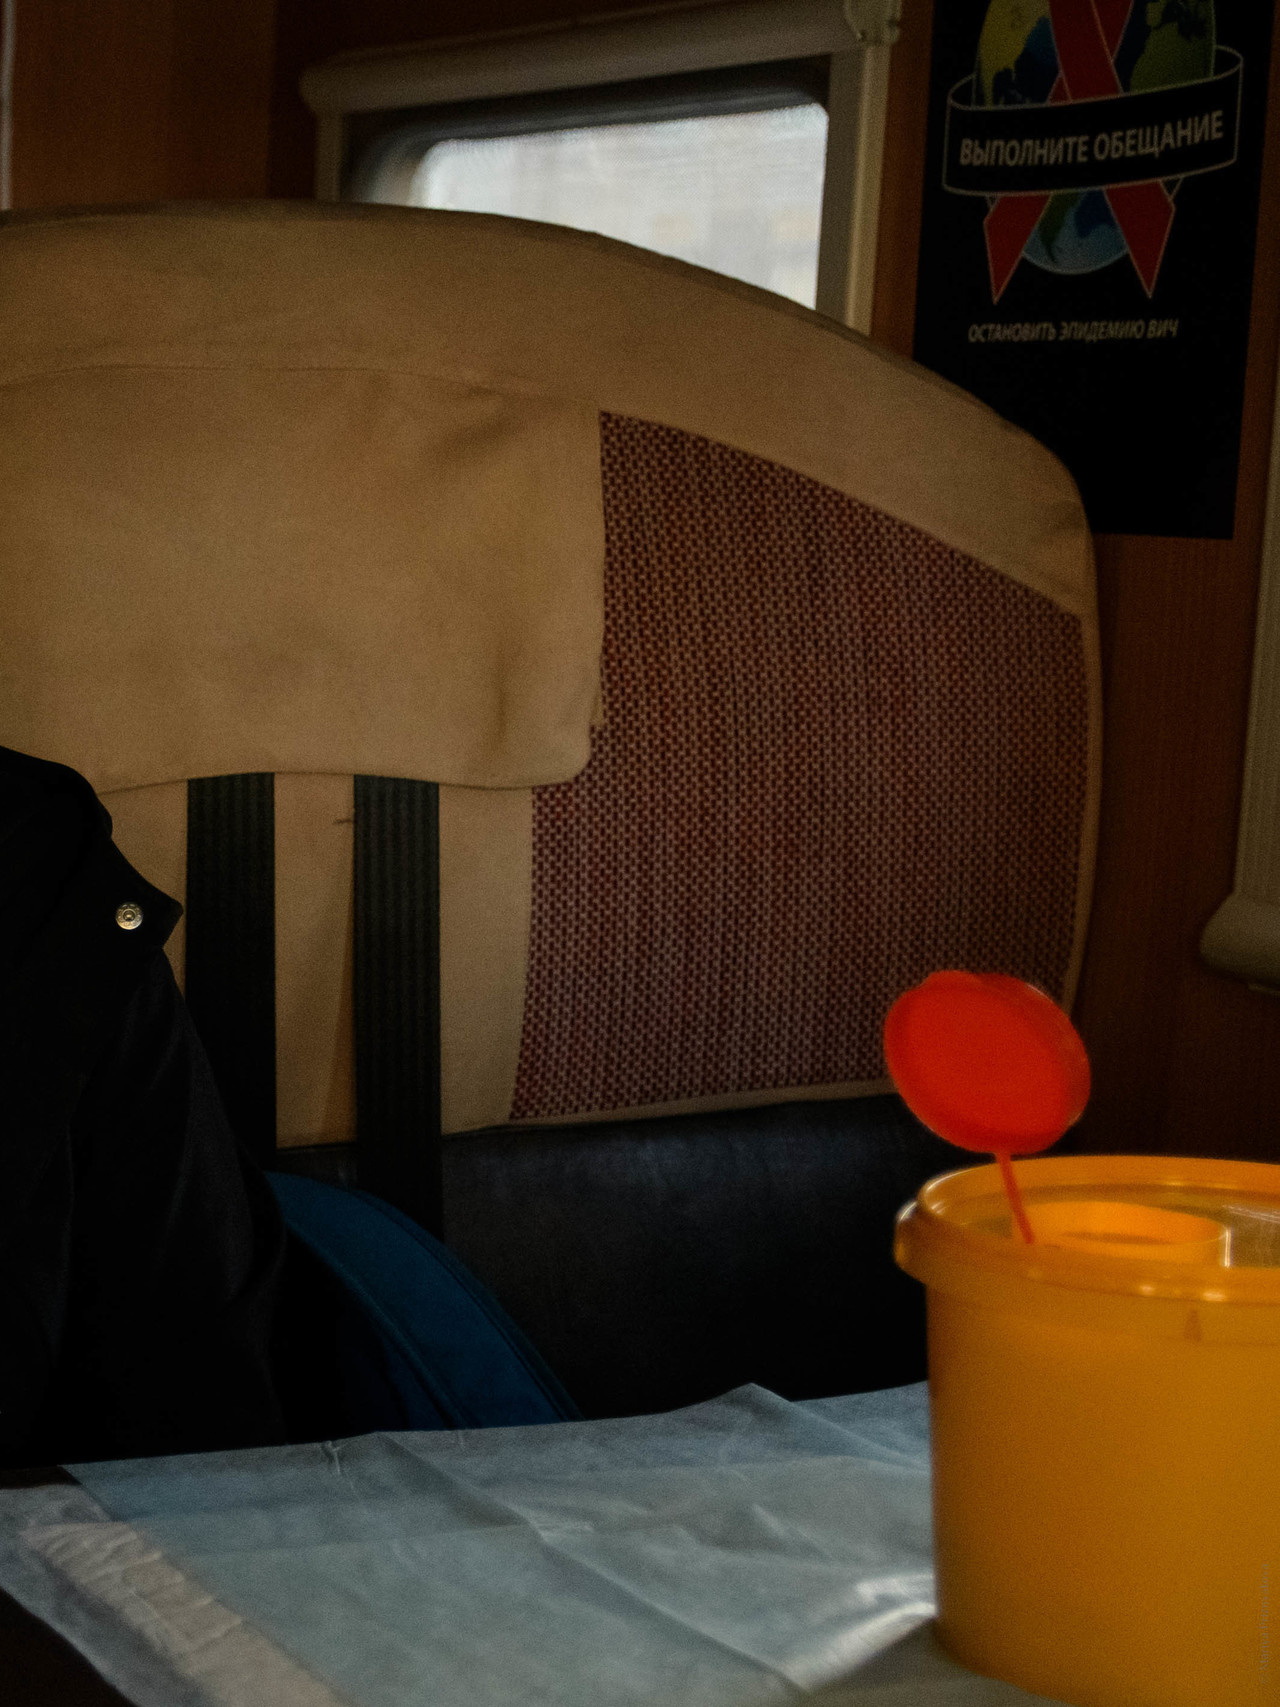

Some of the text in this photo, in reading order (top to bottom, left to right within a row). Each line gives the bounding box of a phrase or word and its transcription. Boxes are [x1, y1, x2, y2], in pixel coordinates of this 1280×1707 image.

[959, 110, 1224, 166] ВЫПОЛНИТЕ ОБЕЩАНИЕ
[968, 317, 1179, 343] ОСТАНОВИТЬ ЭПИДЕМИЮ ВИЧ
